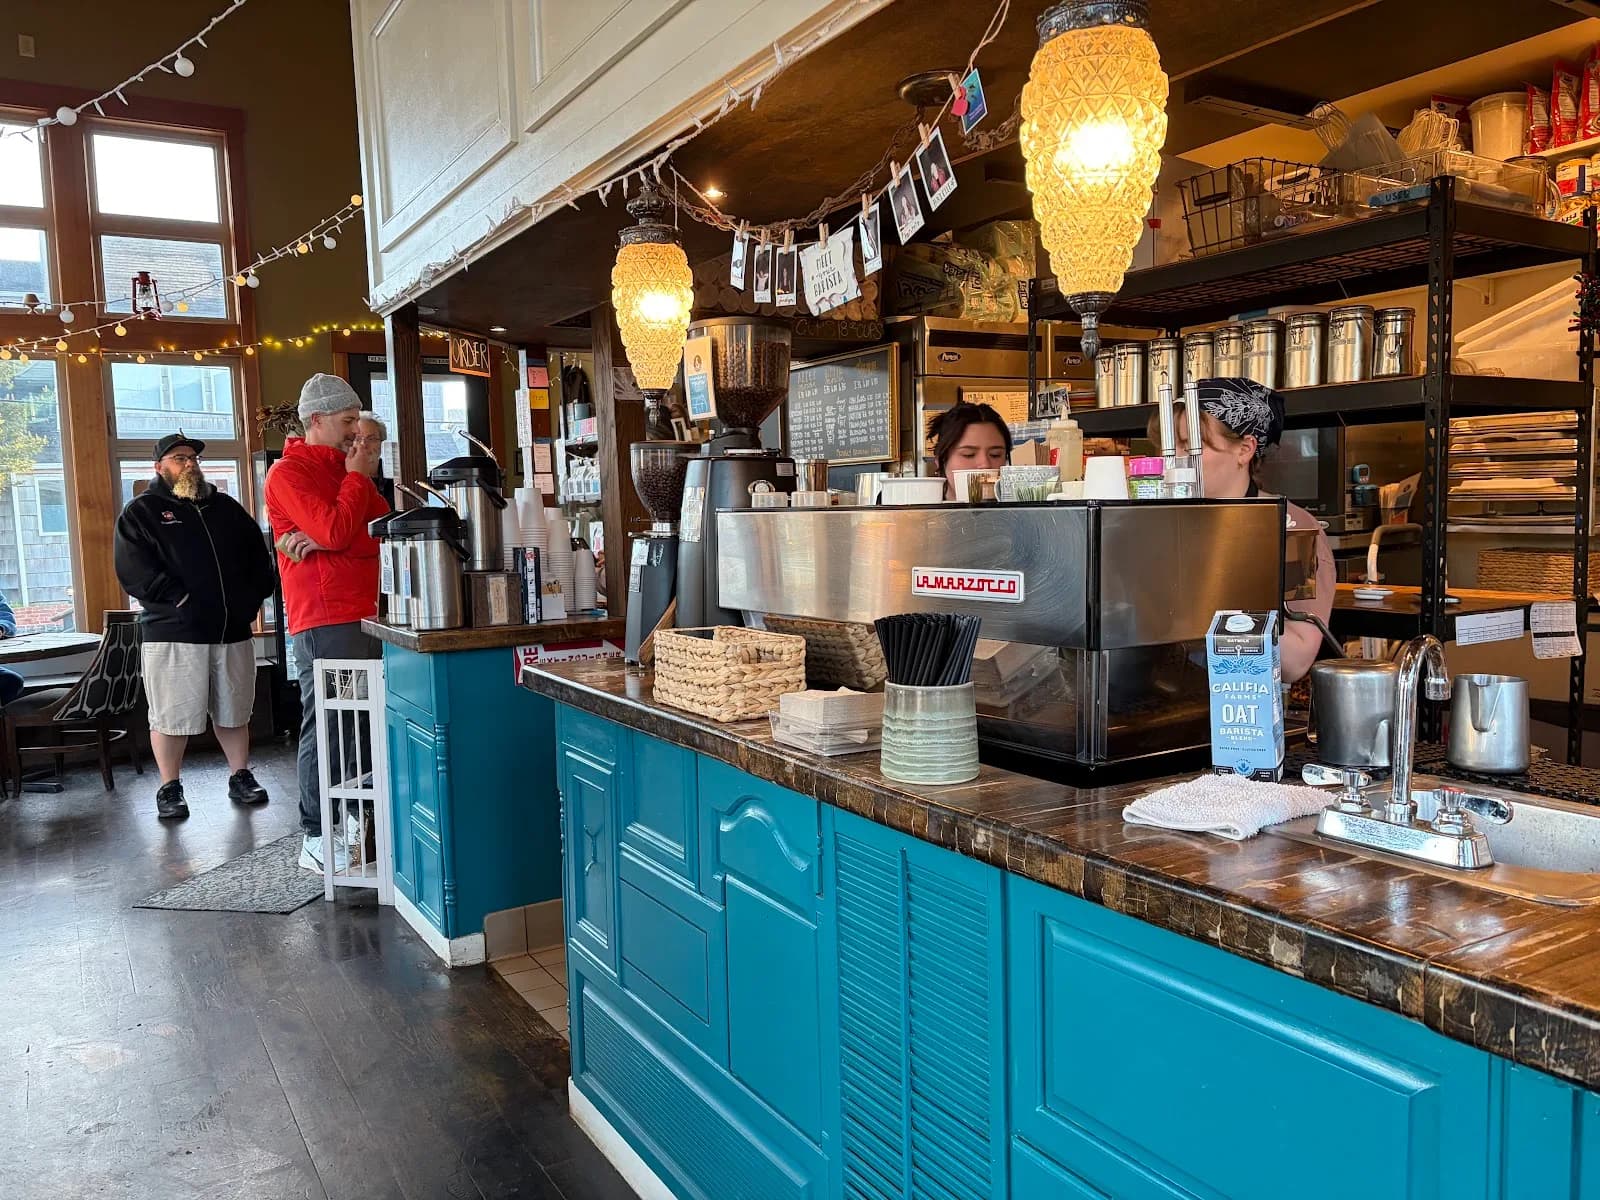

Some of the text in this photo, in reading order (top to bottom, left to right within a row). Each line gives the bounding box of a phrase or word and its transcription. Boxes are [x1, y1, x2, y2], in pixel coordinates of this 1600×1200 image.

[816, 250, 832, 272] MEET
[814, 270, 843, 297] BARISTA
[452, 337, 489, 369] ORDER
[523, 646, 539, 665] RE
[1212, 681, 1269, 695] CALIFIA
[1222, 704, 1260, 725] OAT
[1219, 727, 1264, 737] BARISTA
